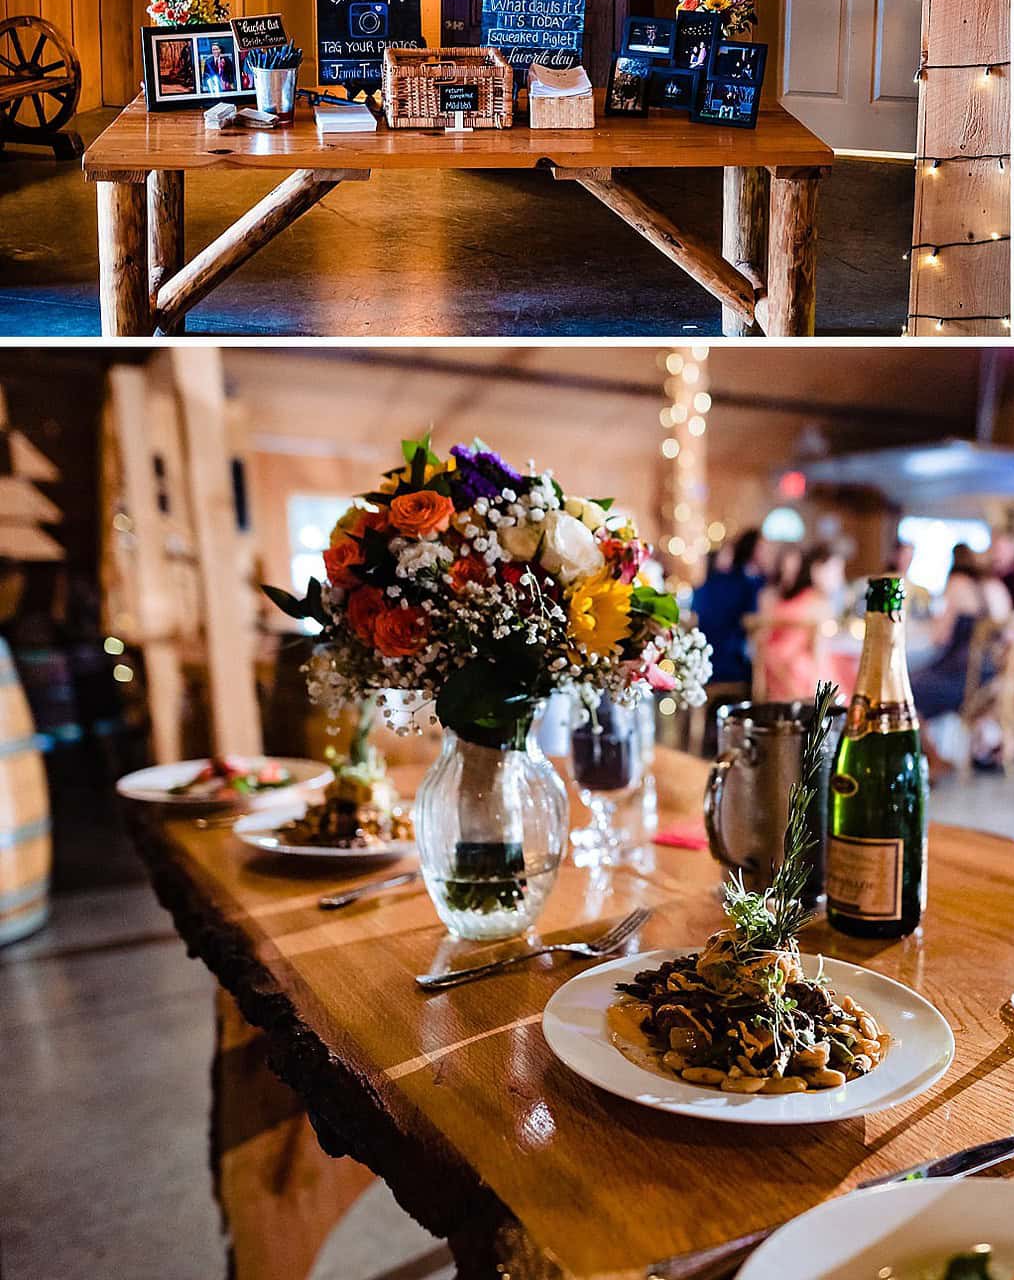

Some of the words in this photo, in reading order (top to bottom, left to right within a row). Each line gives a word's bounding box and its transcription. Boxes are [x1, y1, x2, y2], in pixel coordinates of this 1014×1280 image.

[490, 31, 539, 44] squeaked
[345, 41, 375, 53] YOUR
[507, 46, 550, 64] favorite
[550, 48, 575, 70] day
